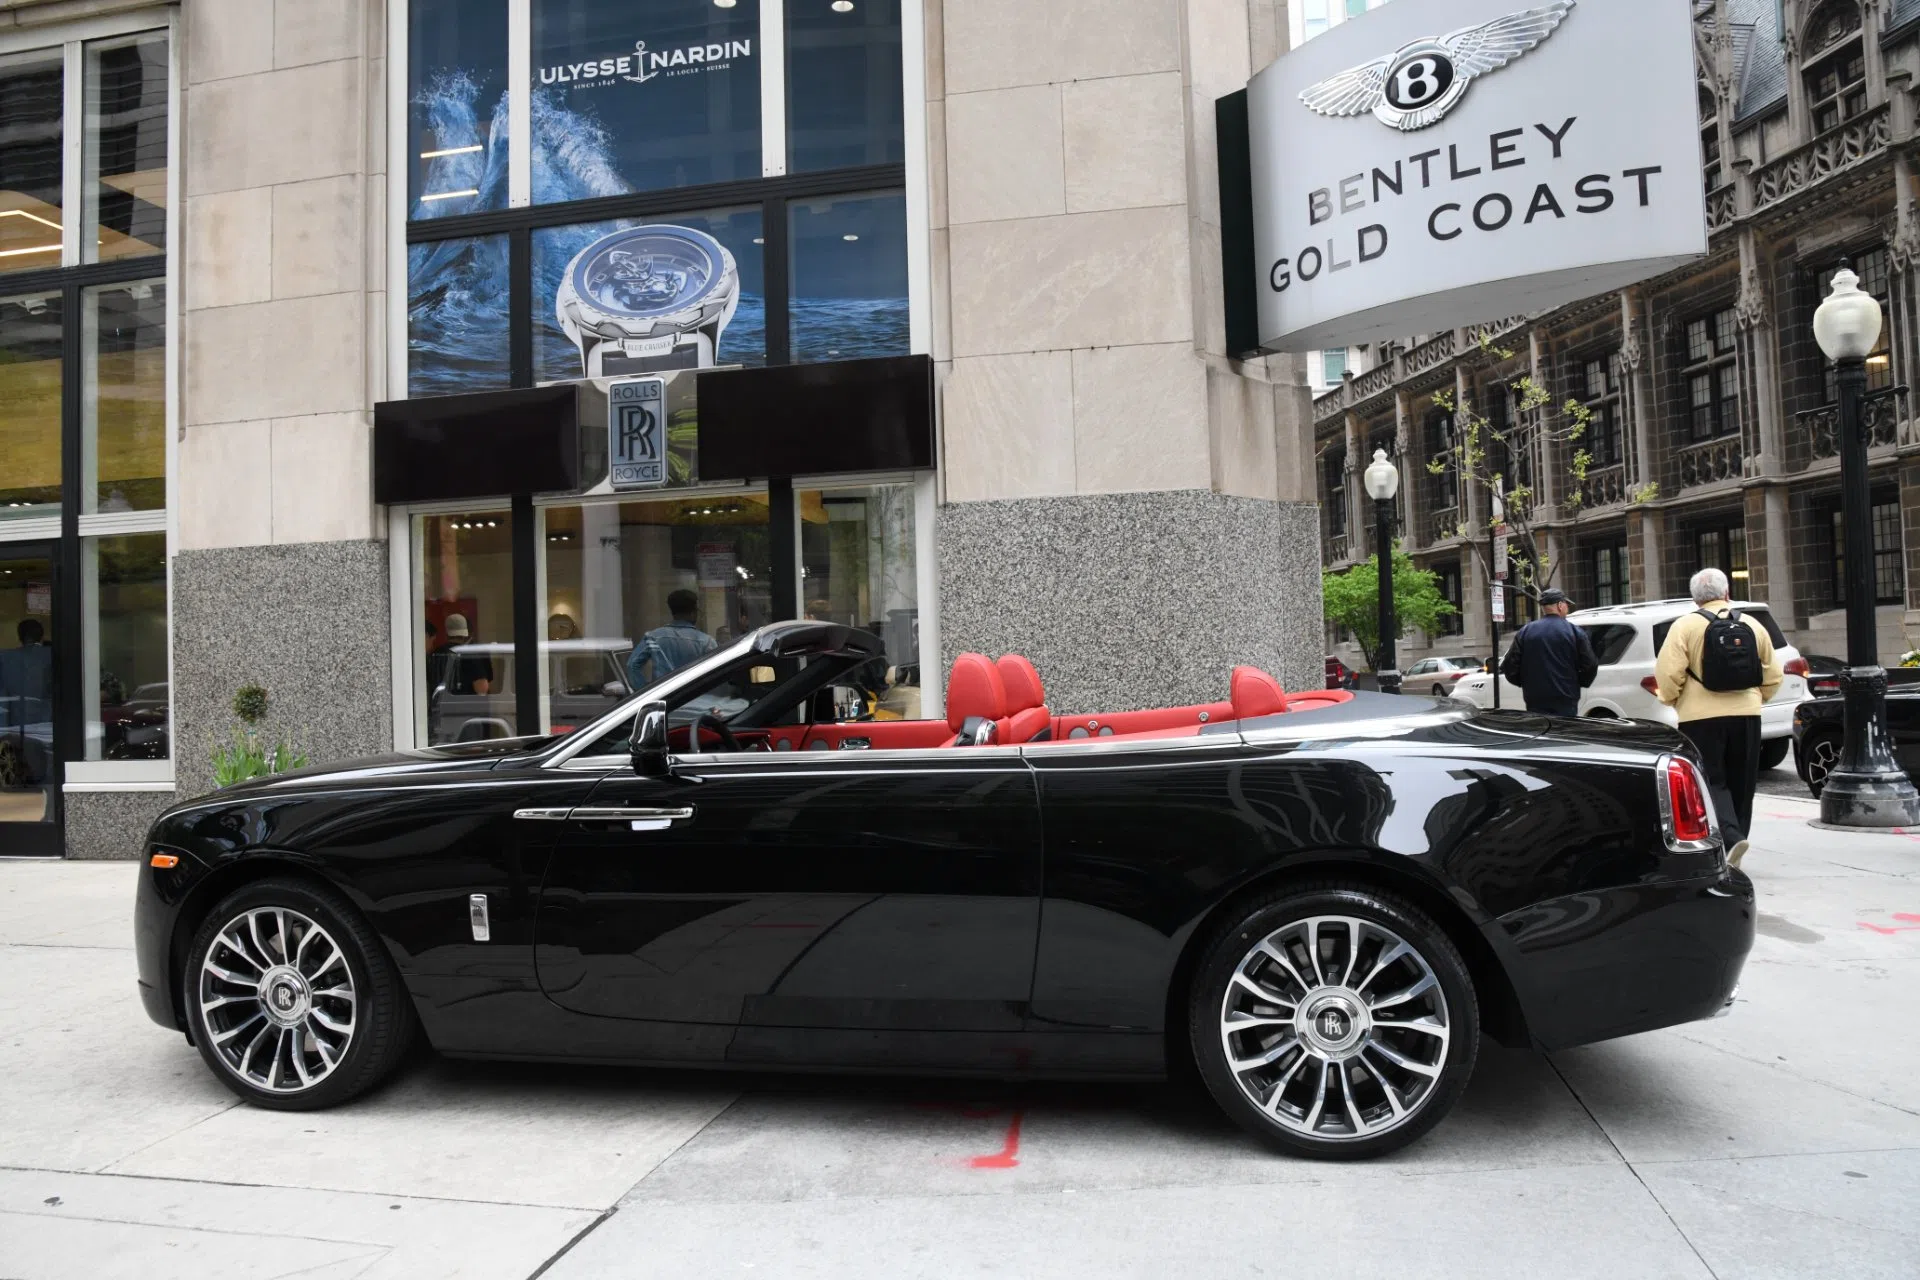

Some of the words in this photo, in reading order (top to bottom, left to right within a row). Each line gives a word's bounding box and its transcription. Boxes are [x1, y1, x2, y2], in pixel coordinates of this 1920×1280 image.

[540, 56, 631, 85] ULYSSE
[650, 39, 752, 69] NARDIN
[706, 63, 730, 72] SUISSE
[573, 82, 595, 90] SINCE
[598, 78, 616, 87] 1846
[1308, 116, 1578, 226] BENTLEY
[1269, 223, 1388, 293] GOLD
[1427, 165, 1663, 241] COAST
[613, 384, 659, 400] ROLLS
[614, 464, 660, 480] ROYCE
